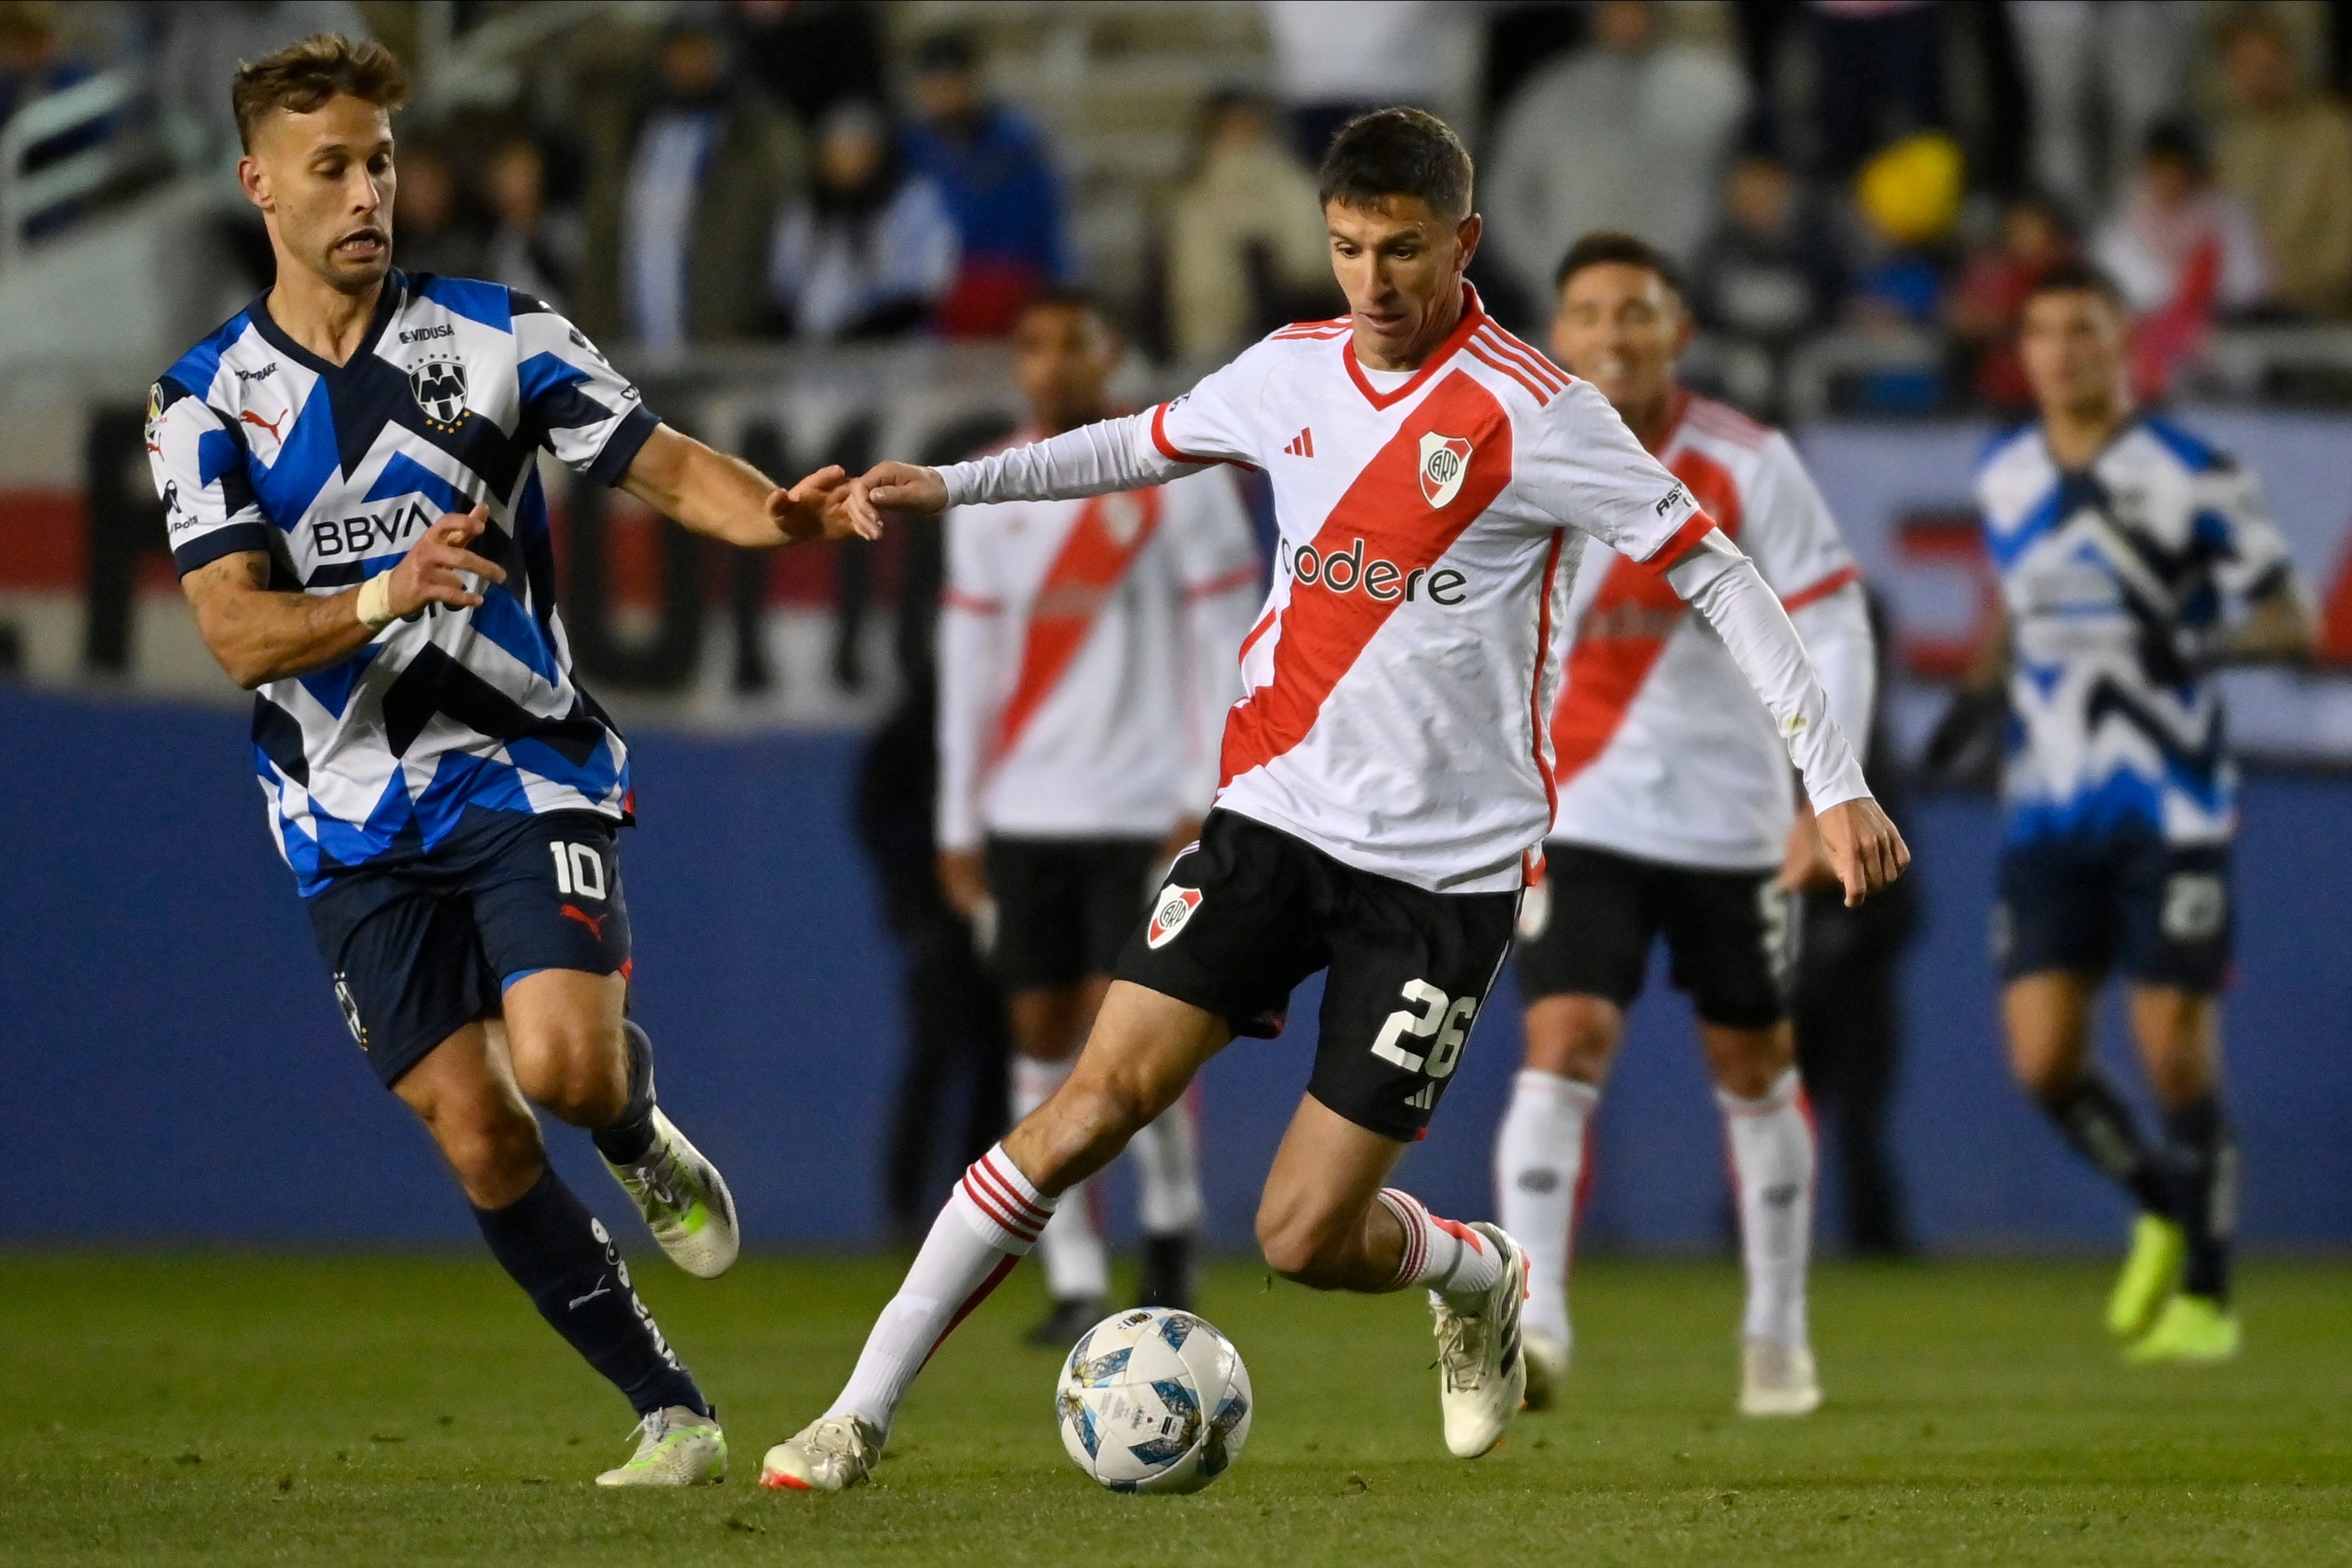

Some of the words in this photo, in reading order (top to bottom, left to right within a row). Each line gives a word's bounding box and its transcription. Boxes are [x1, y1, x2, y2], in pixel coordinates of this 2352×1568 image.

[410, 323, 455, 342] VIDUSA
[312, 501, 433, 557] BBVA
[1281, 537, 1468, 606] codere
[550, 841, 607, 900] 10
[1370, 978, 1477, 1079] 26
